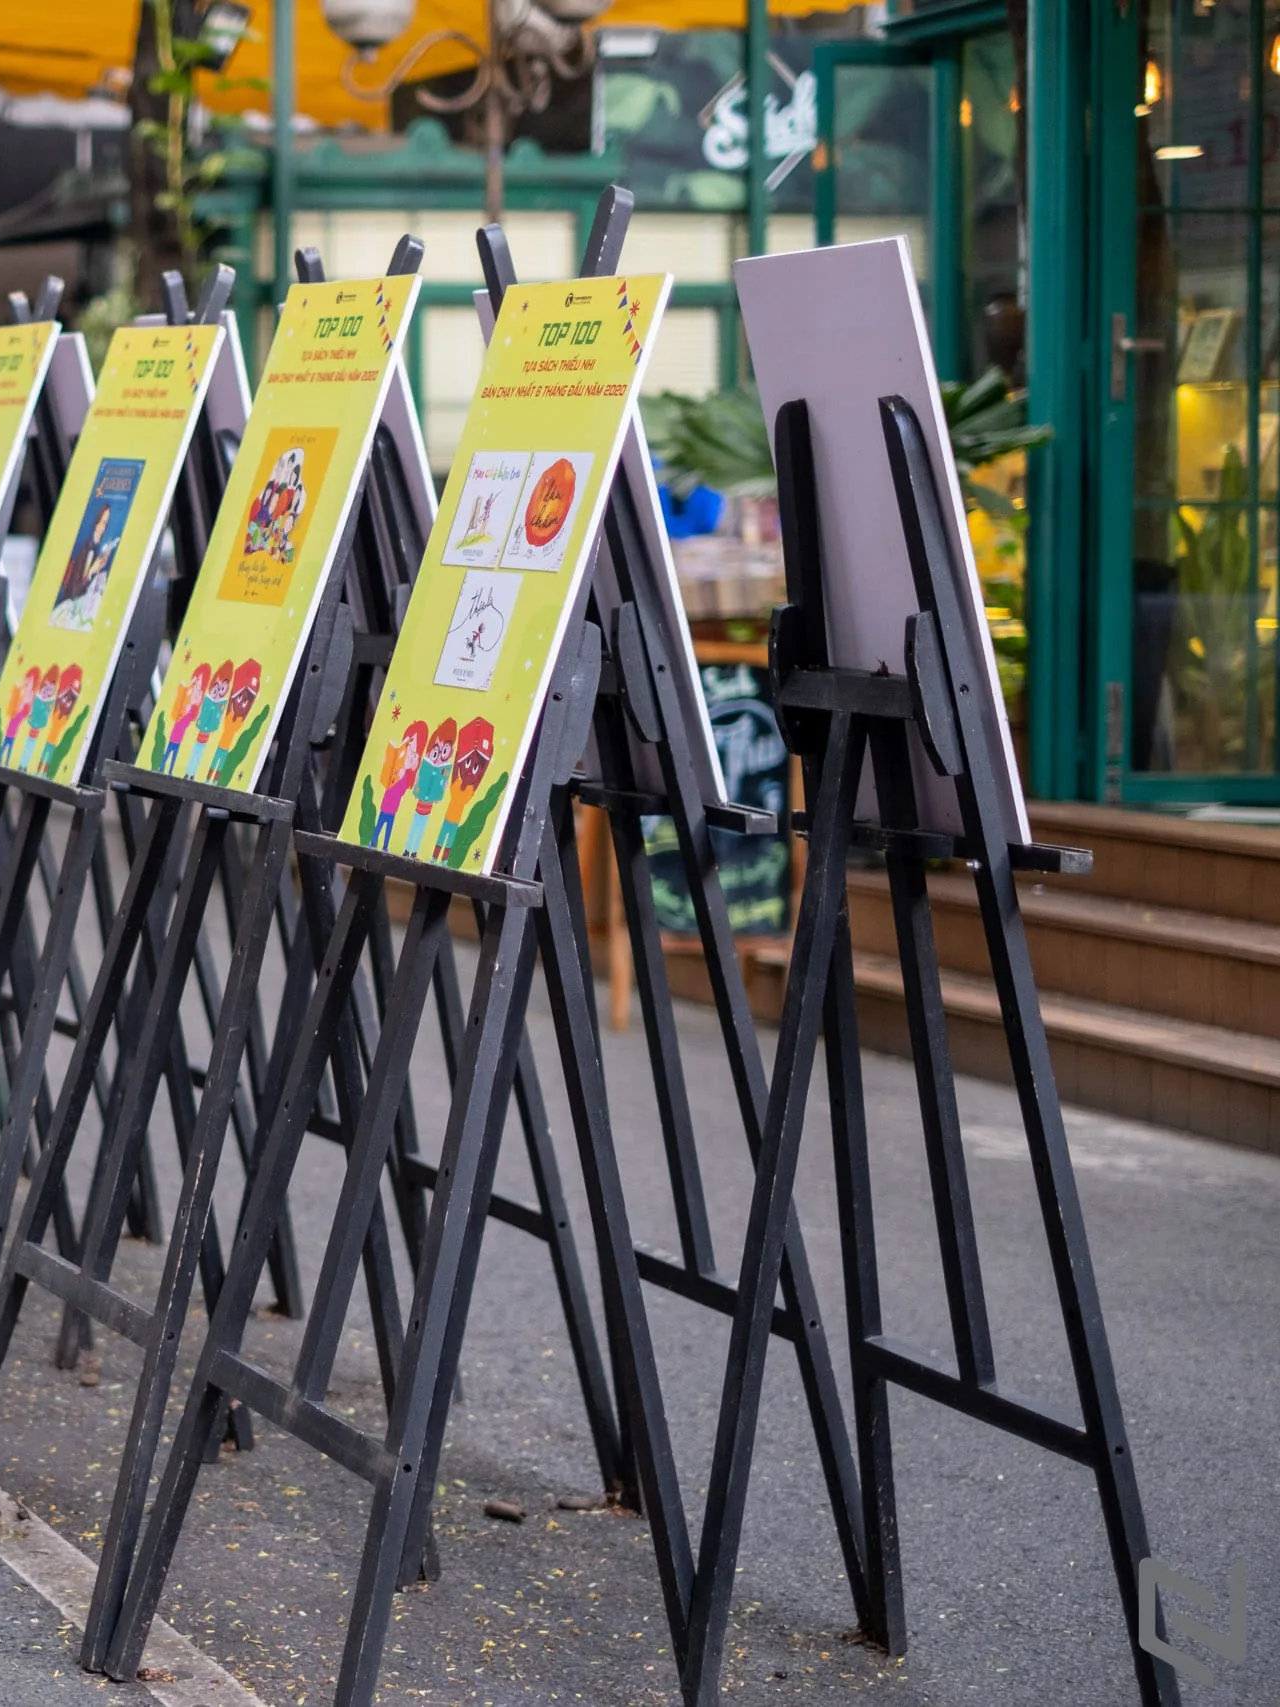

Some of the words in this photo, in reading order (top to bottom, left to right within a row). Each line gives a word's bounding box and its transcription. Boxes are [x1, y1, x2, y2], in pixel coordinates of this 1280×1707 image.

[314, 317, 341, 338] TOP
[339, 316, 364, 336] 100
[538, 321, 571, 347] TOP
[569, 320, 602, 346] 100
[537, 356, 559, 373] SÁCH
[559, 352, 581, 372] THIẾU
[581, 359, 595, 371] NHI
[584, 381, 605, 396] NĂM
[603, 384, 628, 396] 2020
